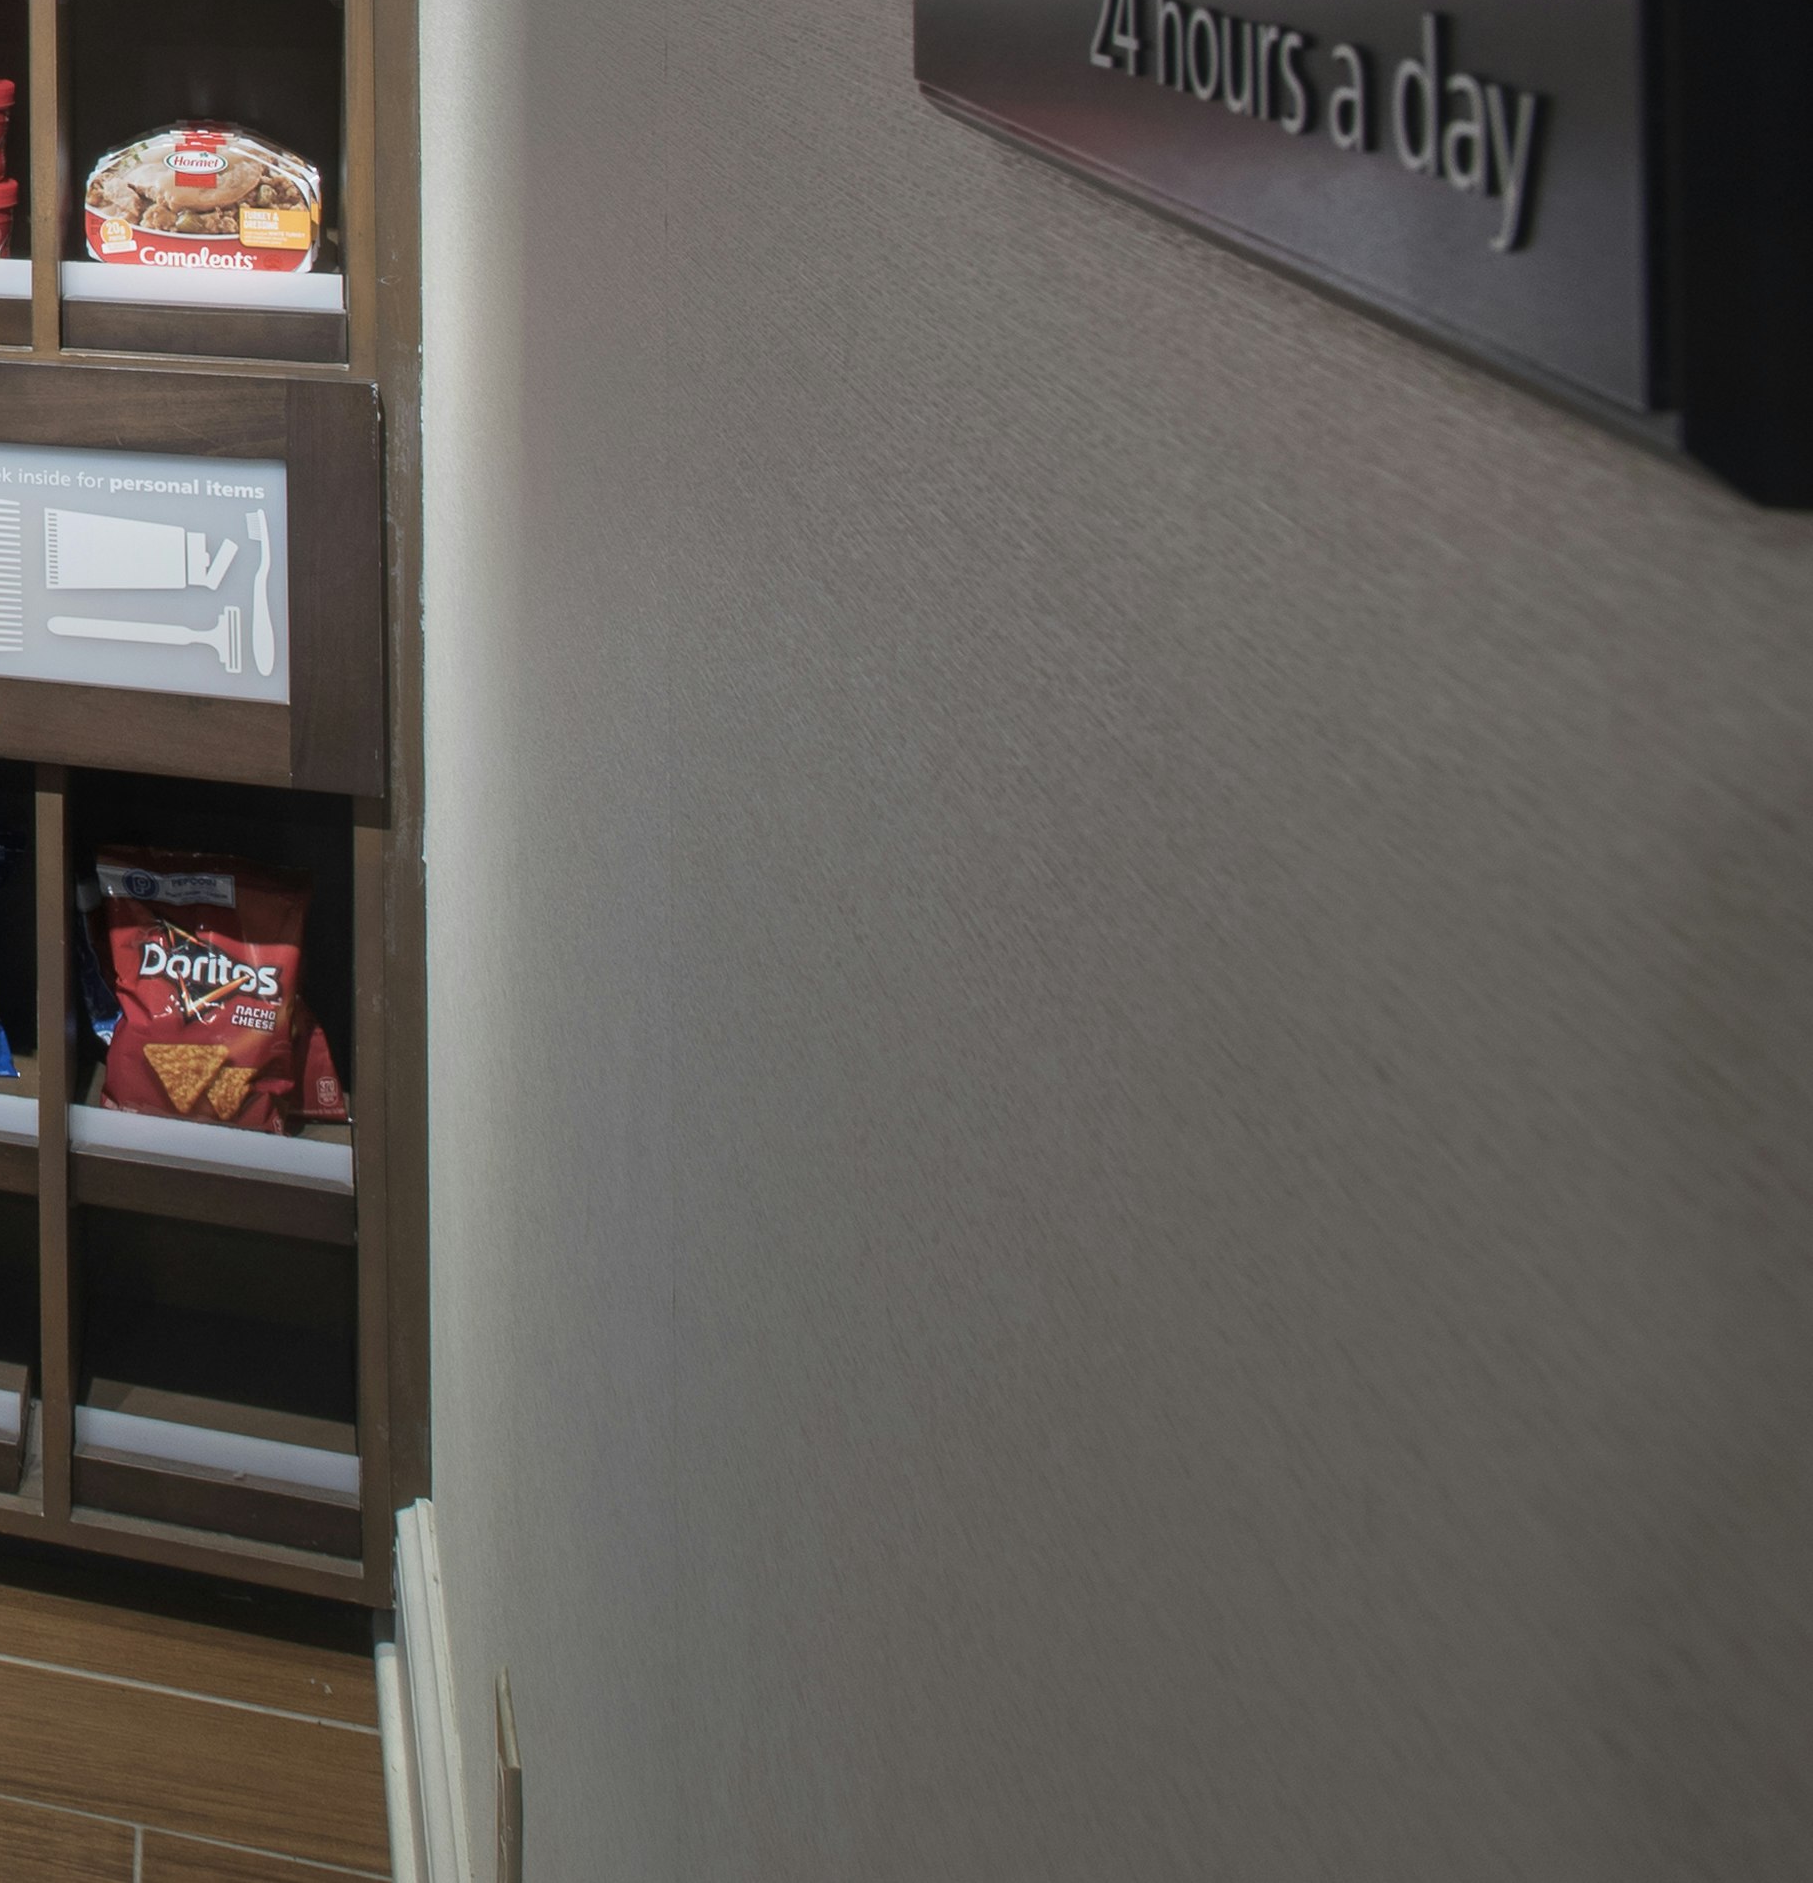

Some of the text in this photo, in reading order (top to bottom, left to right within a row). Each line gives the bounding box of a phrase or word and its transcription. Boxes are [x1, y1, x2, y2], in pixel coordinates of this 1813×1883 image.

[1328, 44, 1365, 151] a
[1392, 13, 1537, 251] day
[173, 154, 220, 169] Hormel
[138, 246, 254, 271] Compleats
[18, 468, 72, 487] inside
[76, 471, 105, 489] for
[109, 475, 200, 495] personal
[205, 480, 266, 500] items
[140, 943, 278, 996] Doritos
[231, 1015, 275, 1031] CHEESE
[236, 1005, 276, 1021] NACHO
